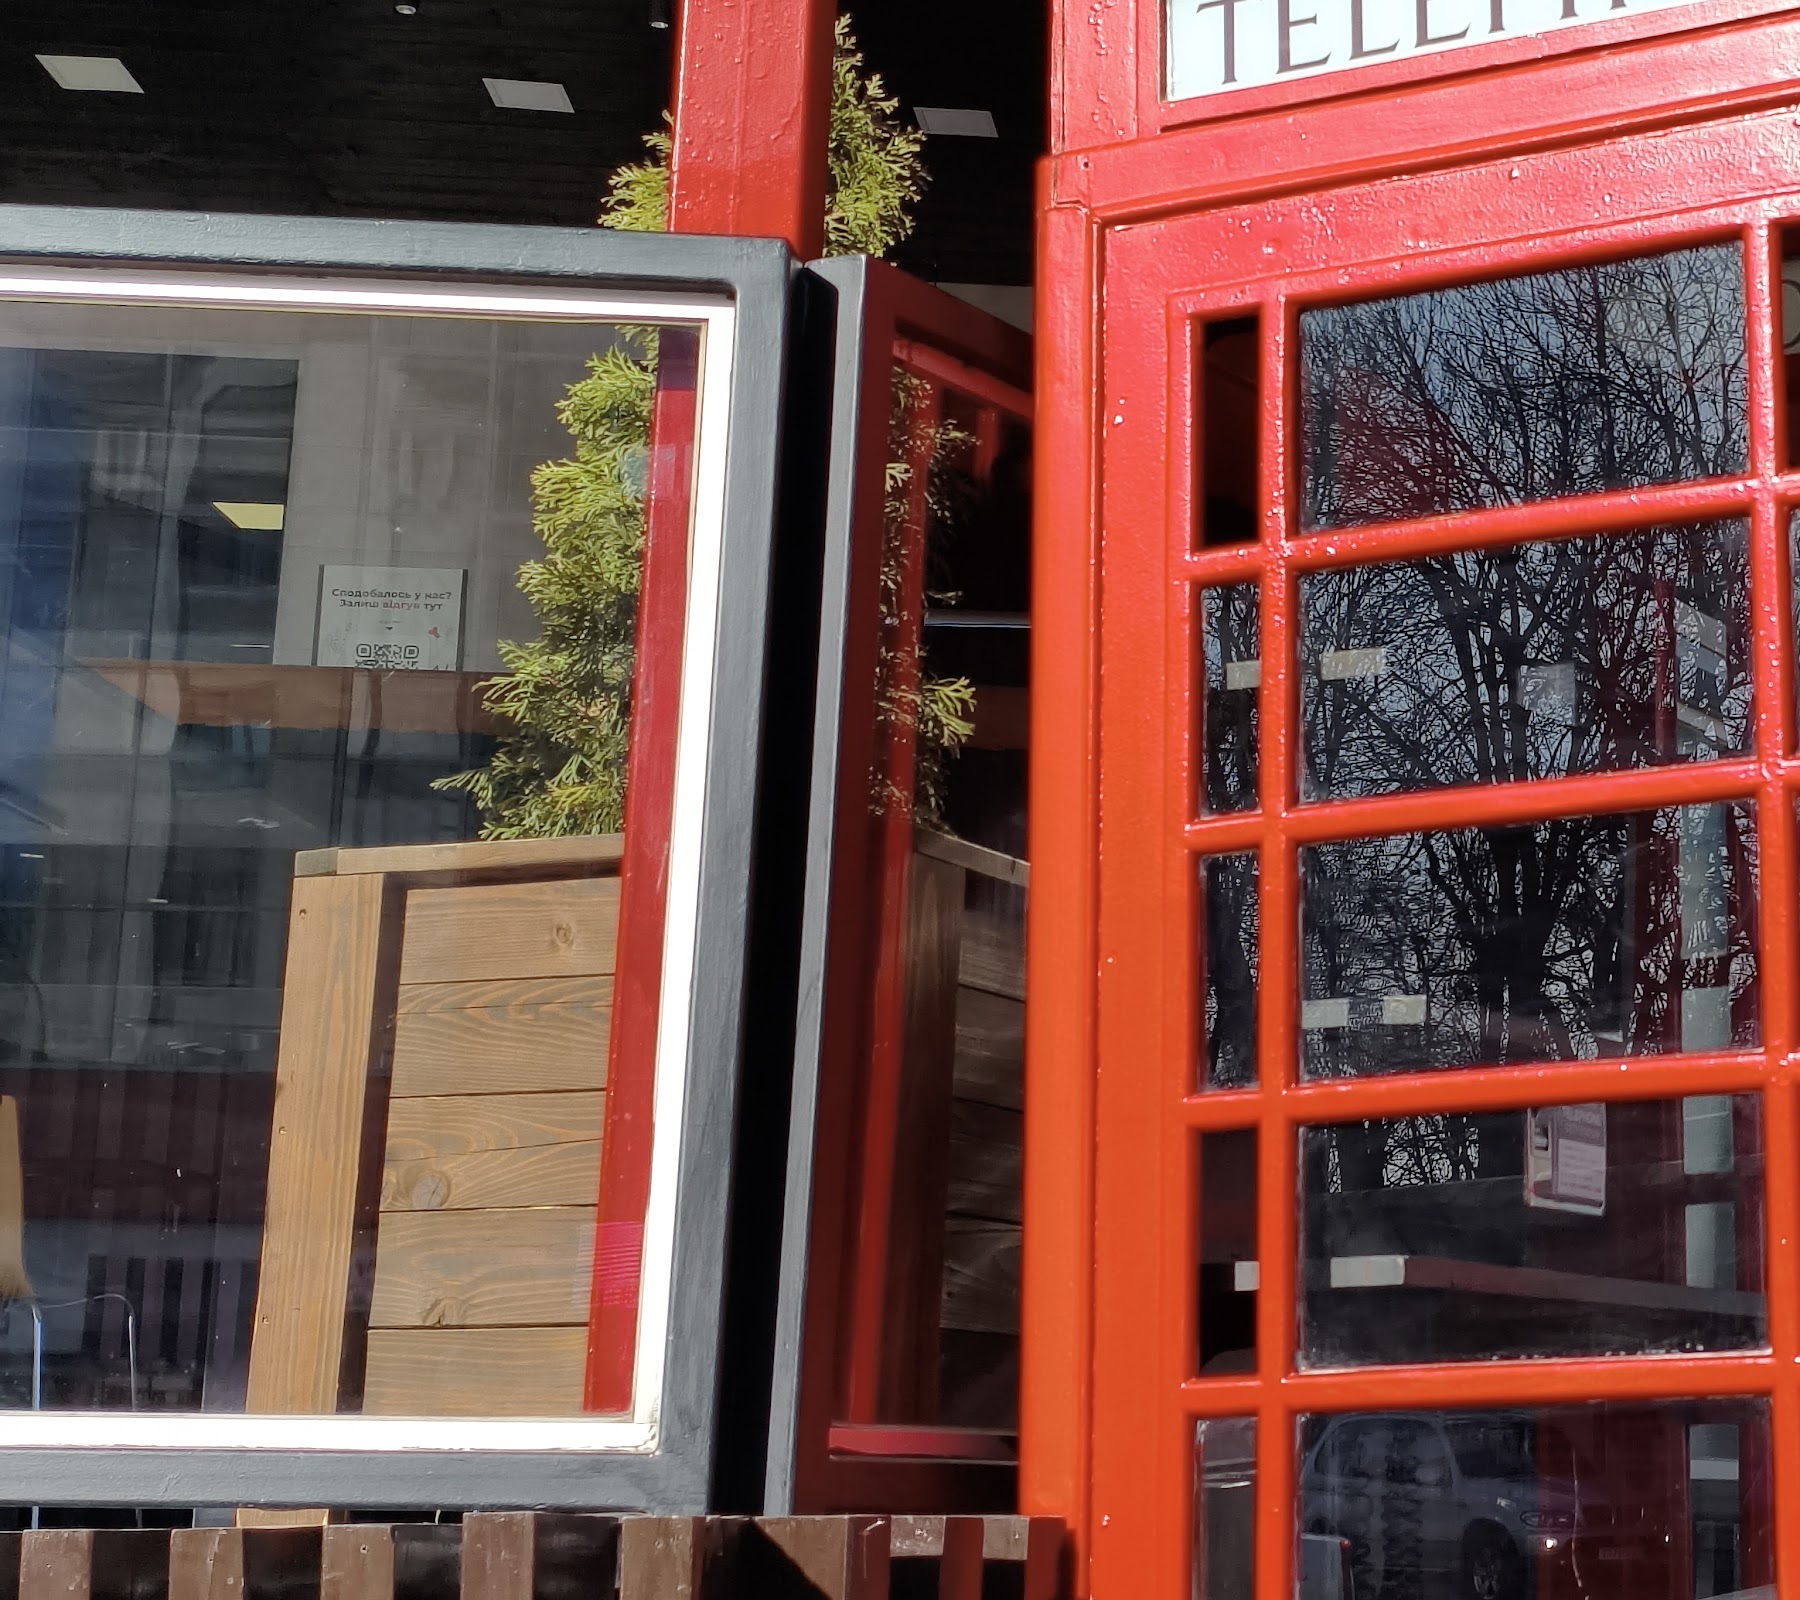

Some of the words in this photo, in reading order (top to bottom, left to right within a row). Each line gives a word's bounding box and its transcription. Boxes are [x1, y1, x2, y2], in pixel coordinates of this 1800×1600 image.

[331, 588, 412, 599] Сподобалось
[424, 591, 452, 600] нас?
[423, 603, 444, 612] тут
